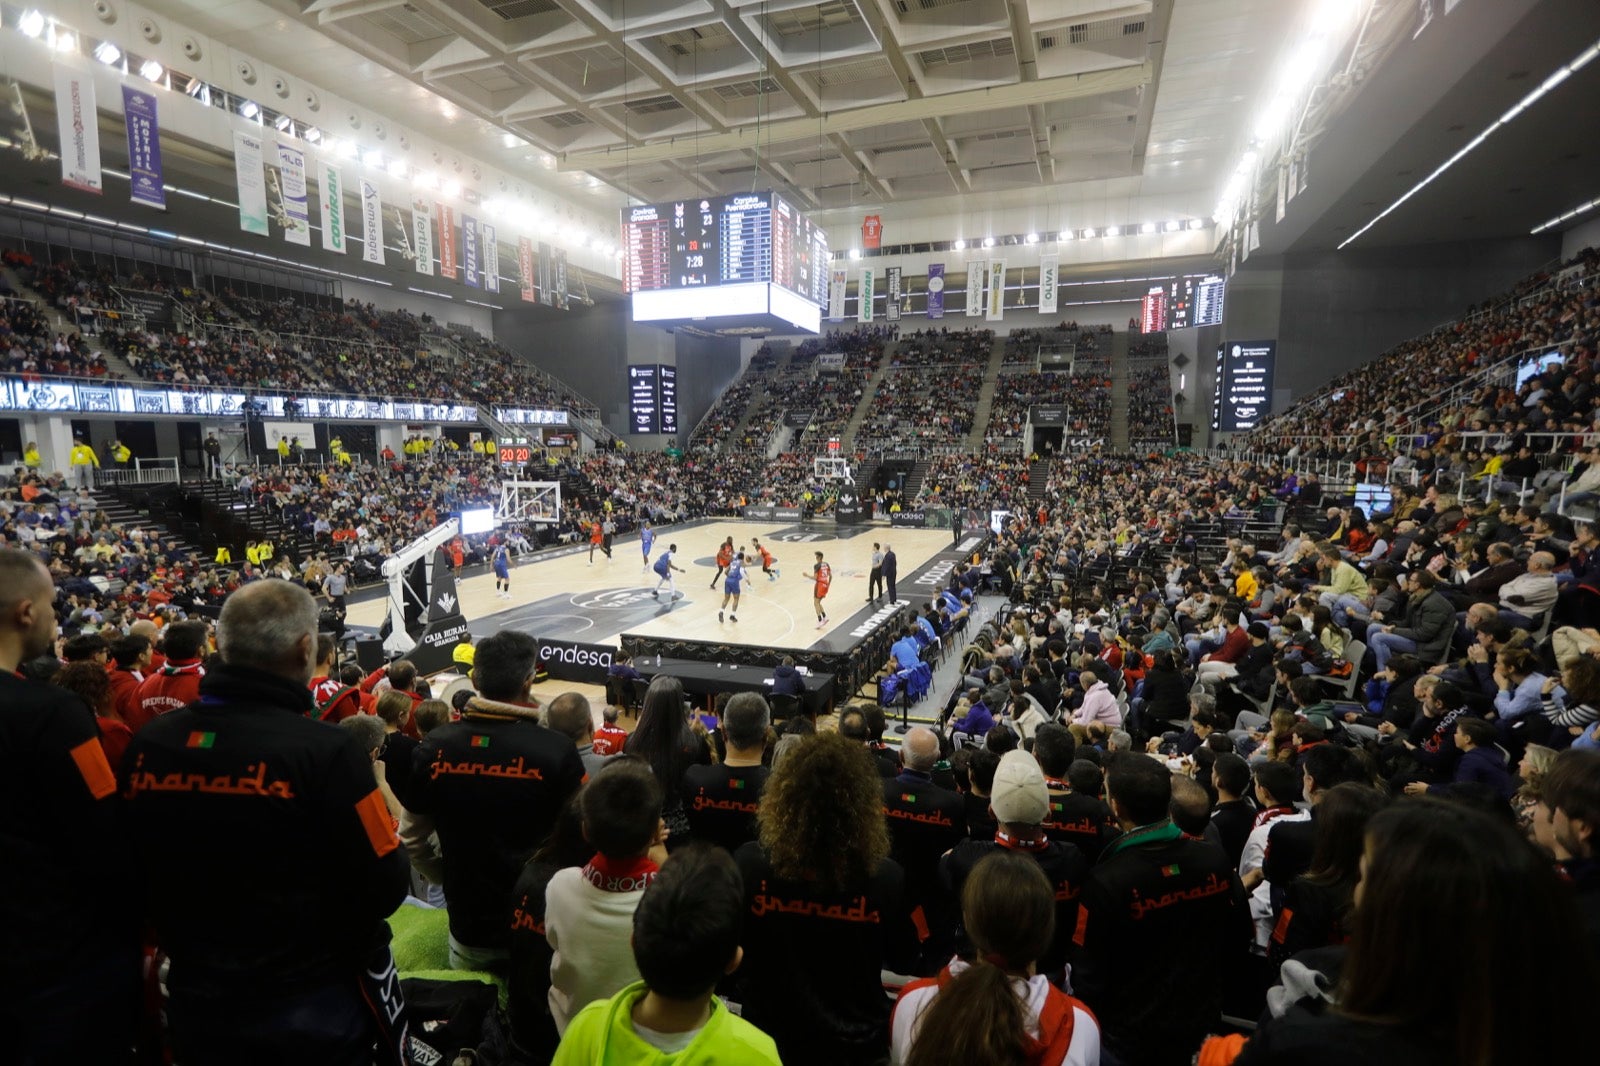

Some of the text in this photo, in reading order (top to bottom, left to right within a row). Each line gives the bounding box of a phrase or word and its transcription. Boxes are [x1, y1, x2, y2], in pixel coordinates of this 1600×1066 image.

[140, 118, 151, 170] MOTRIL
[327, 167, 342, 249] COVIRAN
[675, 217, 684, 229] 31
[703, 214, 713, 226] 23
[367, 202, 378, 261] emasagra
[416, 215, 428, 272] fertisac
[466, 221, 477, 284] PULEVA
[863, 271, 872, 320] COVIRAN
[1045, 268, 1053, 300] OLIVA
[501, 448, 528, 461] 20 20
[424, 624, 467, 644] CAJA RURAL
[434, 634, 459, 648] GRANADA
[540, 644, 612, 668] endesa
